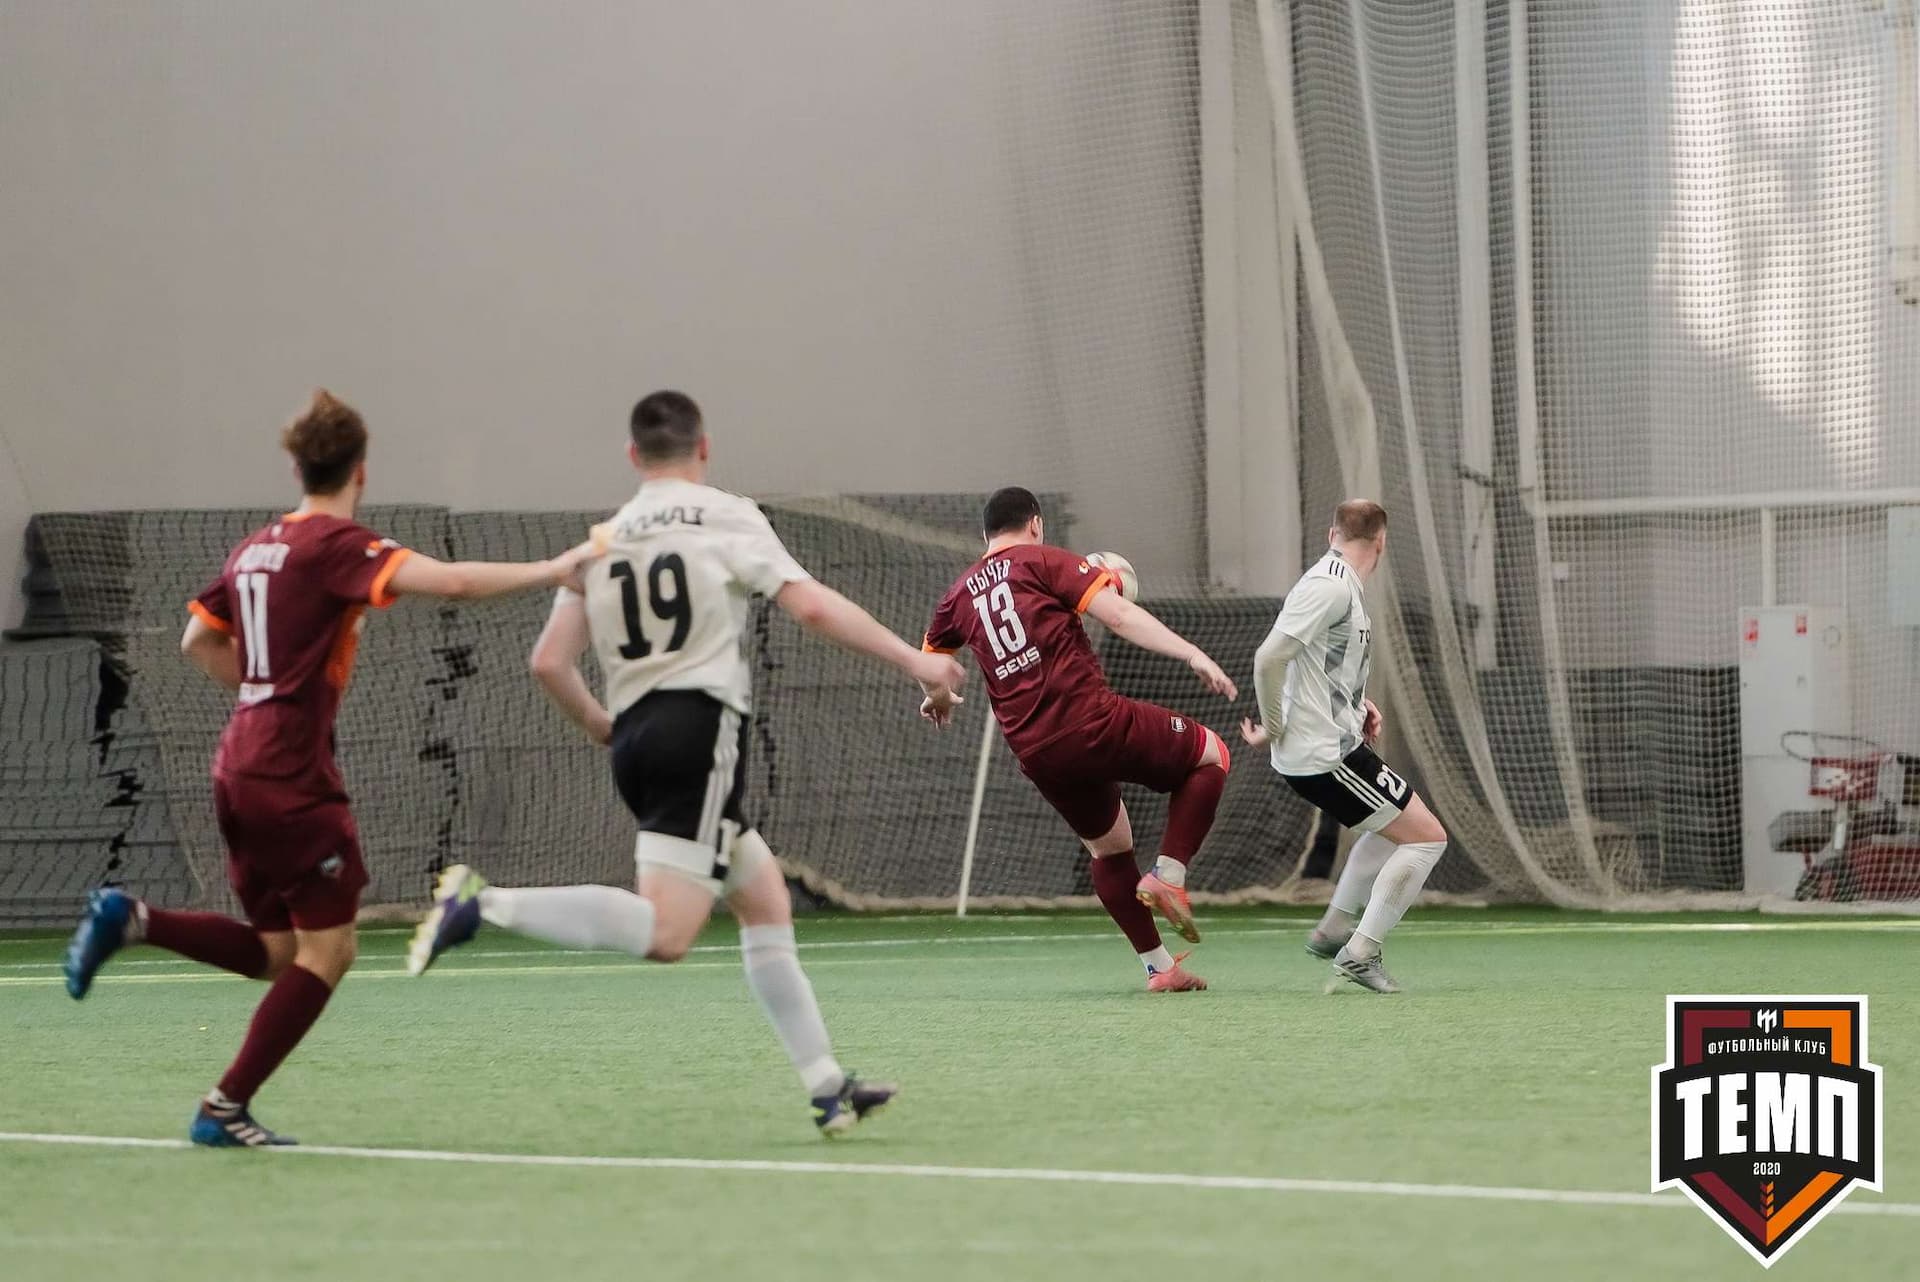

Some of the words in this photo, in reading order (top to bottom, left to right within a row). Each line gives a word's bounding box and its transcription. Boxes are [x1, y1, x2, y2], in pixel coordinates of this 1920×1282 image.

[235, 572, 270, 679] 11
[609, 553, 692, 660] 19
[972, 581, 1027, 661] 13
[995, 646, 1040, 680] SEUS
